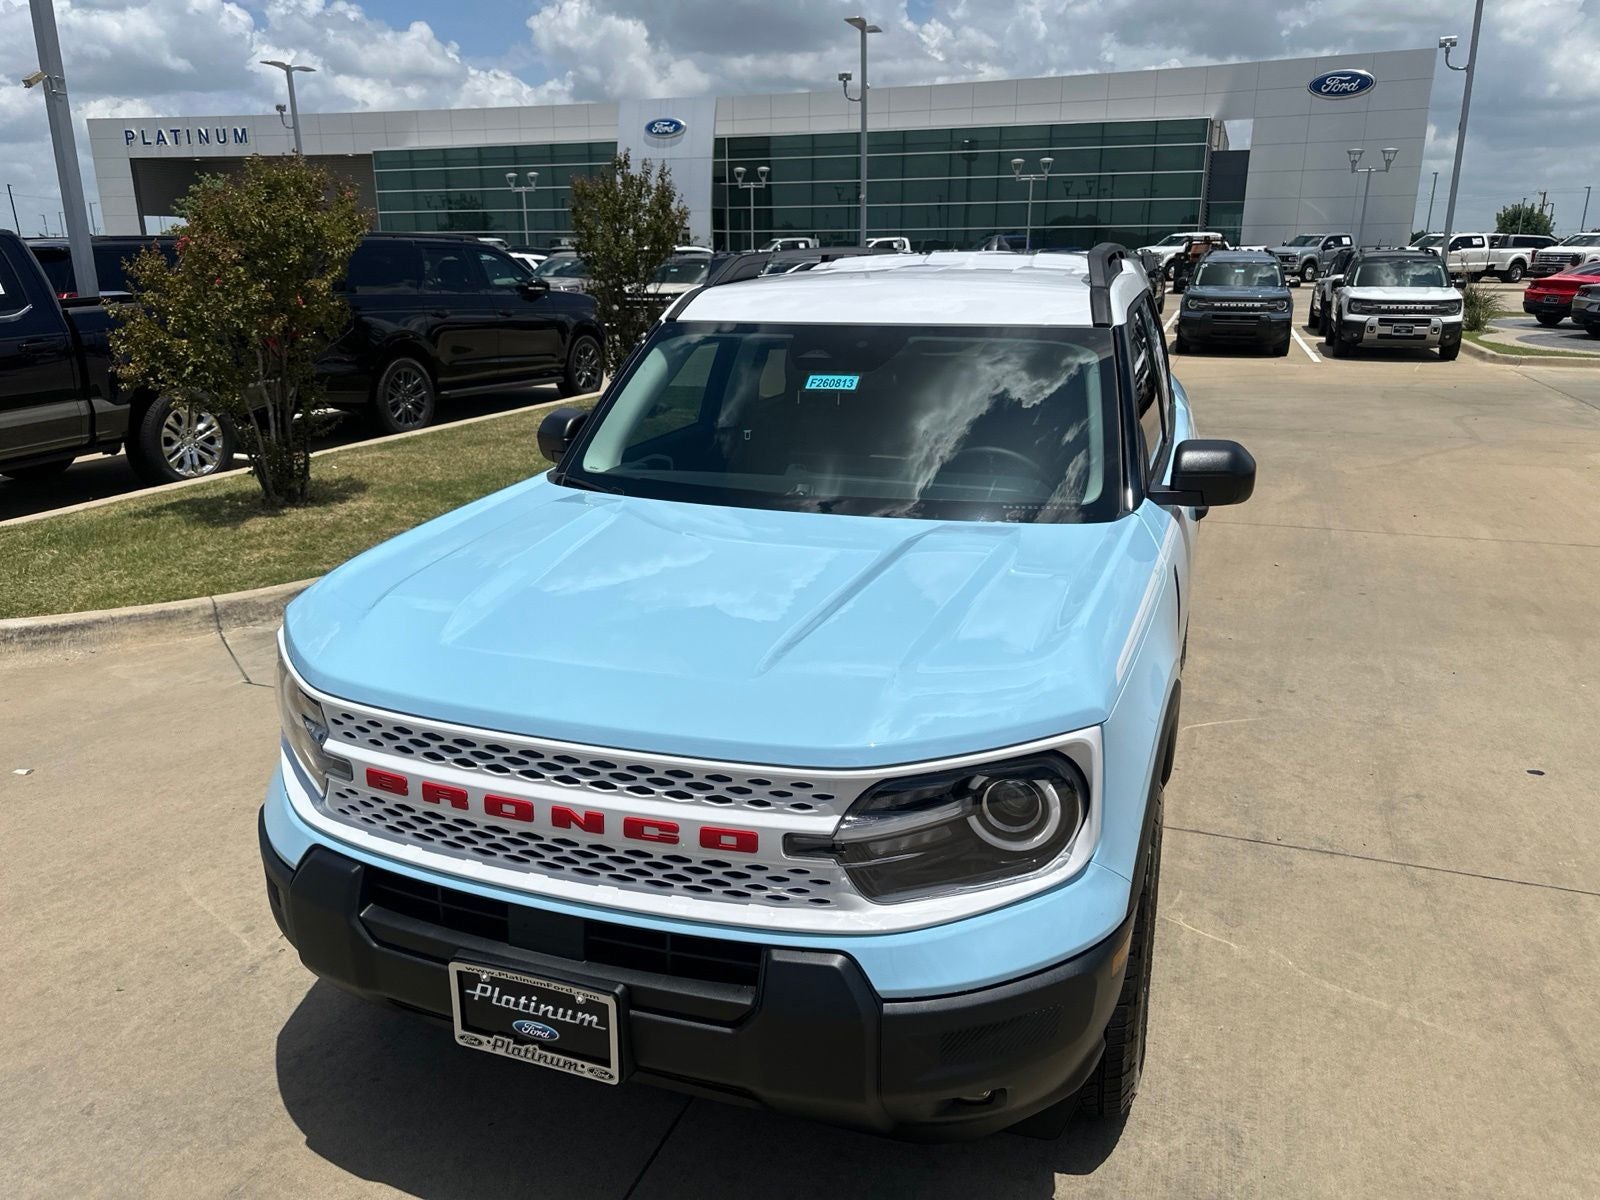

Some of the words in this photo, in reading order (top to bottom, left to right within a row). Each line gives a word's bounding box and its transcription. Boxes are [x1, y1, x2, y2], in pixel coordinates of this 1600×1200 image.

[1321, 76, 1360, 92] Ford
[124, 127, 249, 146] PLATINUM
[652, 121, 675, 133] Ford
[809, 378, 854, 388] F260813
[366, 767, 759, 854] BRONCO
[464, 966, 600, 1001] www.PlatinumFord.com
[465, 983, 606, 1031] Platinum
[521, 1022, 550, 1039] Ford
[492, 1038, 586, 1074] Platinum
